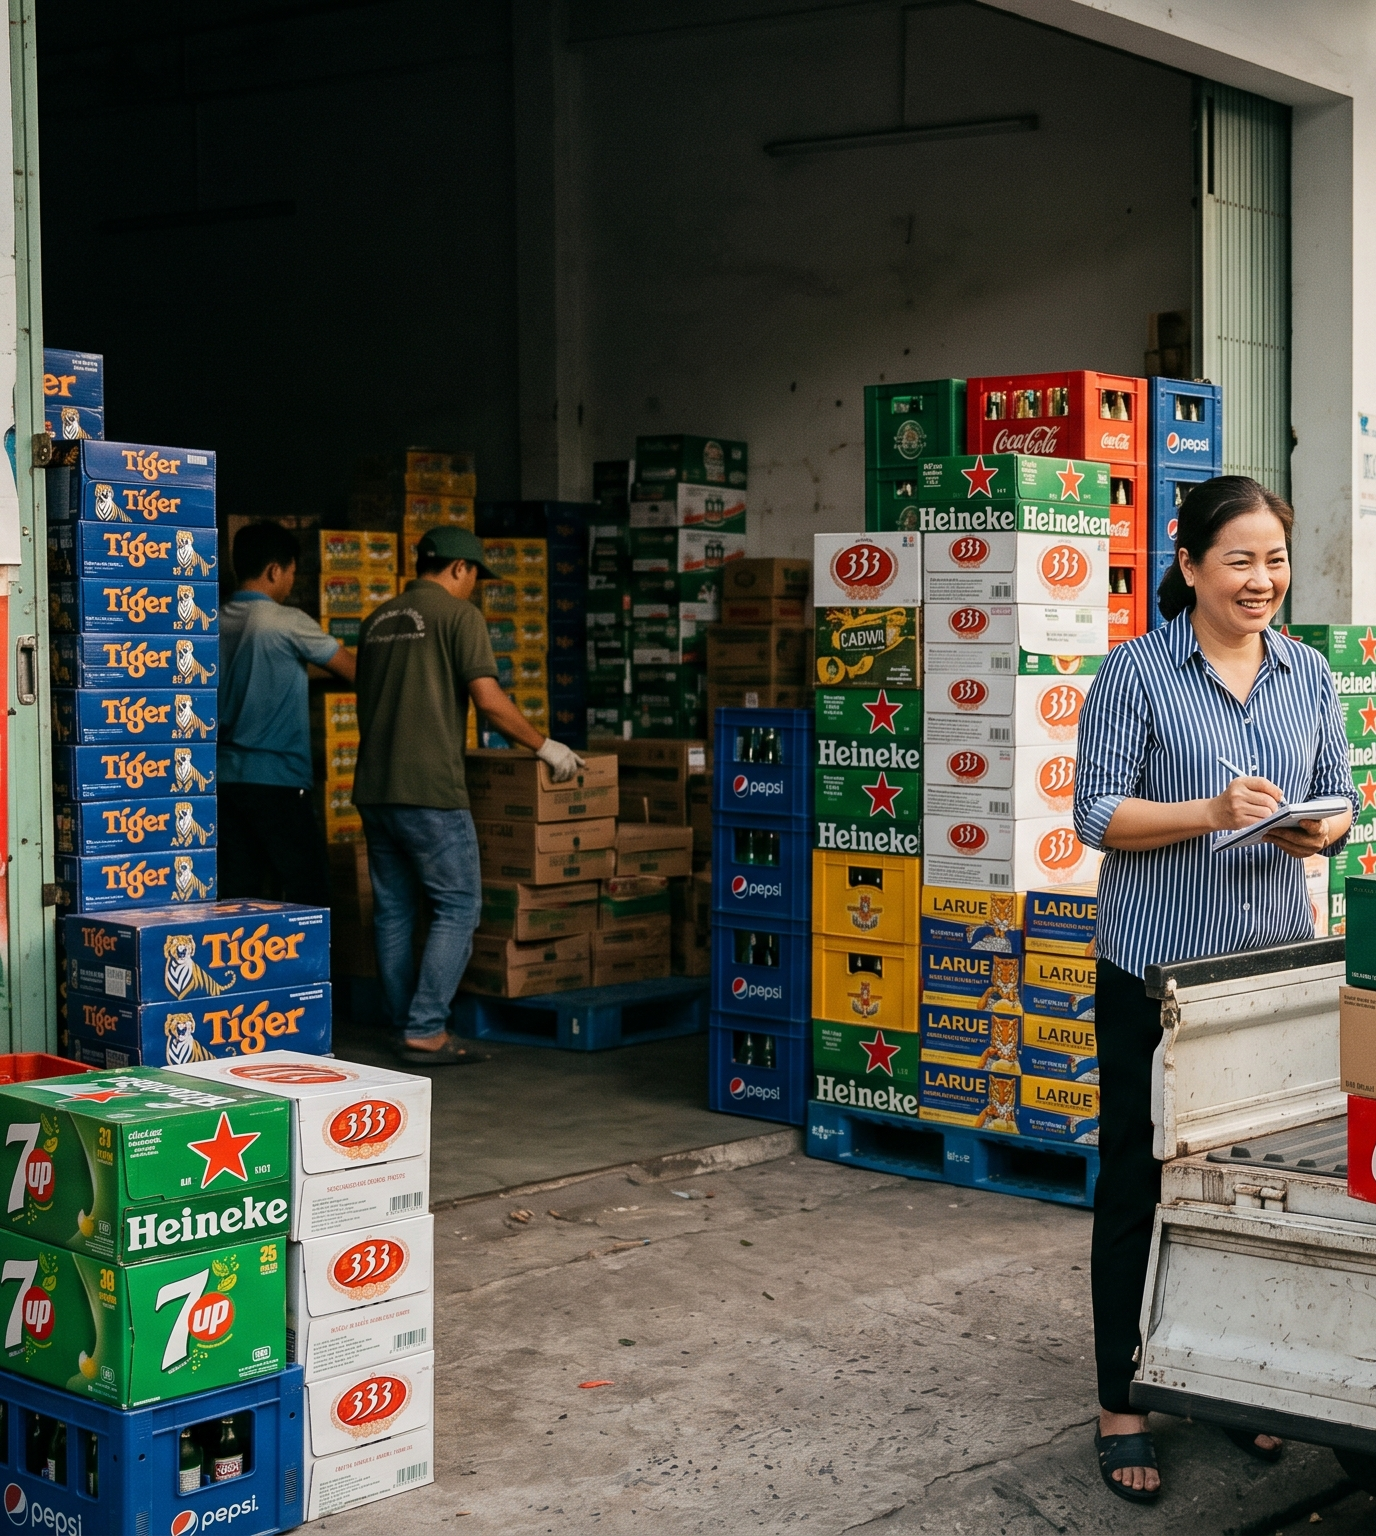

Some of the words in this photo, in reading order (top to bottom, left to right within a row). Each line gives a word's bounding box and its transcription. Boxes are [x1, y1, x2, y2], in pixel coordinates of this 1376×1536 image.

[1180, 437, 1209, 453] pepsi
[122, 450, 180, 480] Tiger
[123, 489, 180, 520] Tiger
[918, 506, 1014, 531] Heineke
[1023, 506, 1110, 536] Heineken
[104, 531, 171, 567] Tiger
[848, 544, 882, 580] 333
[960, 541, 981, 559] 333
[1052, 550, 1079, 581] 333
[103, 586, 171, 623] Tiger
[960, 612, 981, 629] 333
[103, 641, 171, 678] Tiger
[102, 697, 171, 733] Tiger
[1049, 688, 1077, 719] 333
[101, 752, 171, 788] Tiger
[817, 740, 919, 769] Heineke
[750, 780, 783, 797] pepsi
[1049, 759, 1076, 790] 333
[102, 807, 170, 843] Tiger
[818, 822, 919, 854] Heineke
[1048, 833, 1074, 863] 333
[102, 861, 170, 898] Tiger
[748, 882, 781, 899] pepsi
[933, 897, 988, 915] LARUE
[1034, 899, 1097, 920] LARUE
[82, 927, 117, 956] Tiger
[202, 923, 305, 981] Tiger
[929, 954, 990, 976] LARUE
[1039, 964, 1096, 985] LARUE
[748, 981, 781, 1000] pepsi
[82, 1005, 118, 1036] Tiger
[203, 1000, 305, 1054] Tiger
[928, 1012, 989, 1035] LARUE
[1038, 1026, 1095, 1047] LARUE
[747, 1083, 780, 1100] pepsi
[816, 1075, 918, 1115] Heineke
[924, 1070, 987, 1094] LARUE
[1036, 1086, 1093, 1108] LARUE
[344, 1102, 389, 1143] 333
[127, 1197, 288, 1252] Heineke
[347, 1244, 392, 1283] 333
[155, 1268, 231, 1371] 7up
[349, 1381, 393, 1420] 333
[31, 1502, 82, 1536] pepsi
